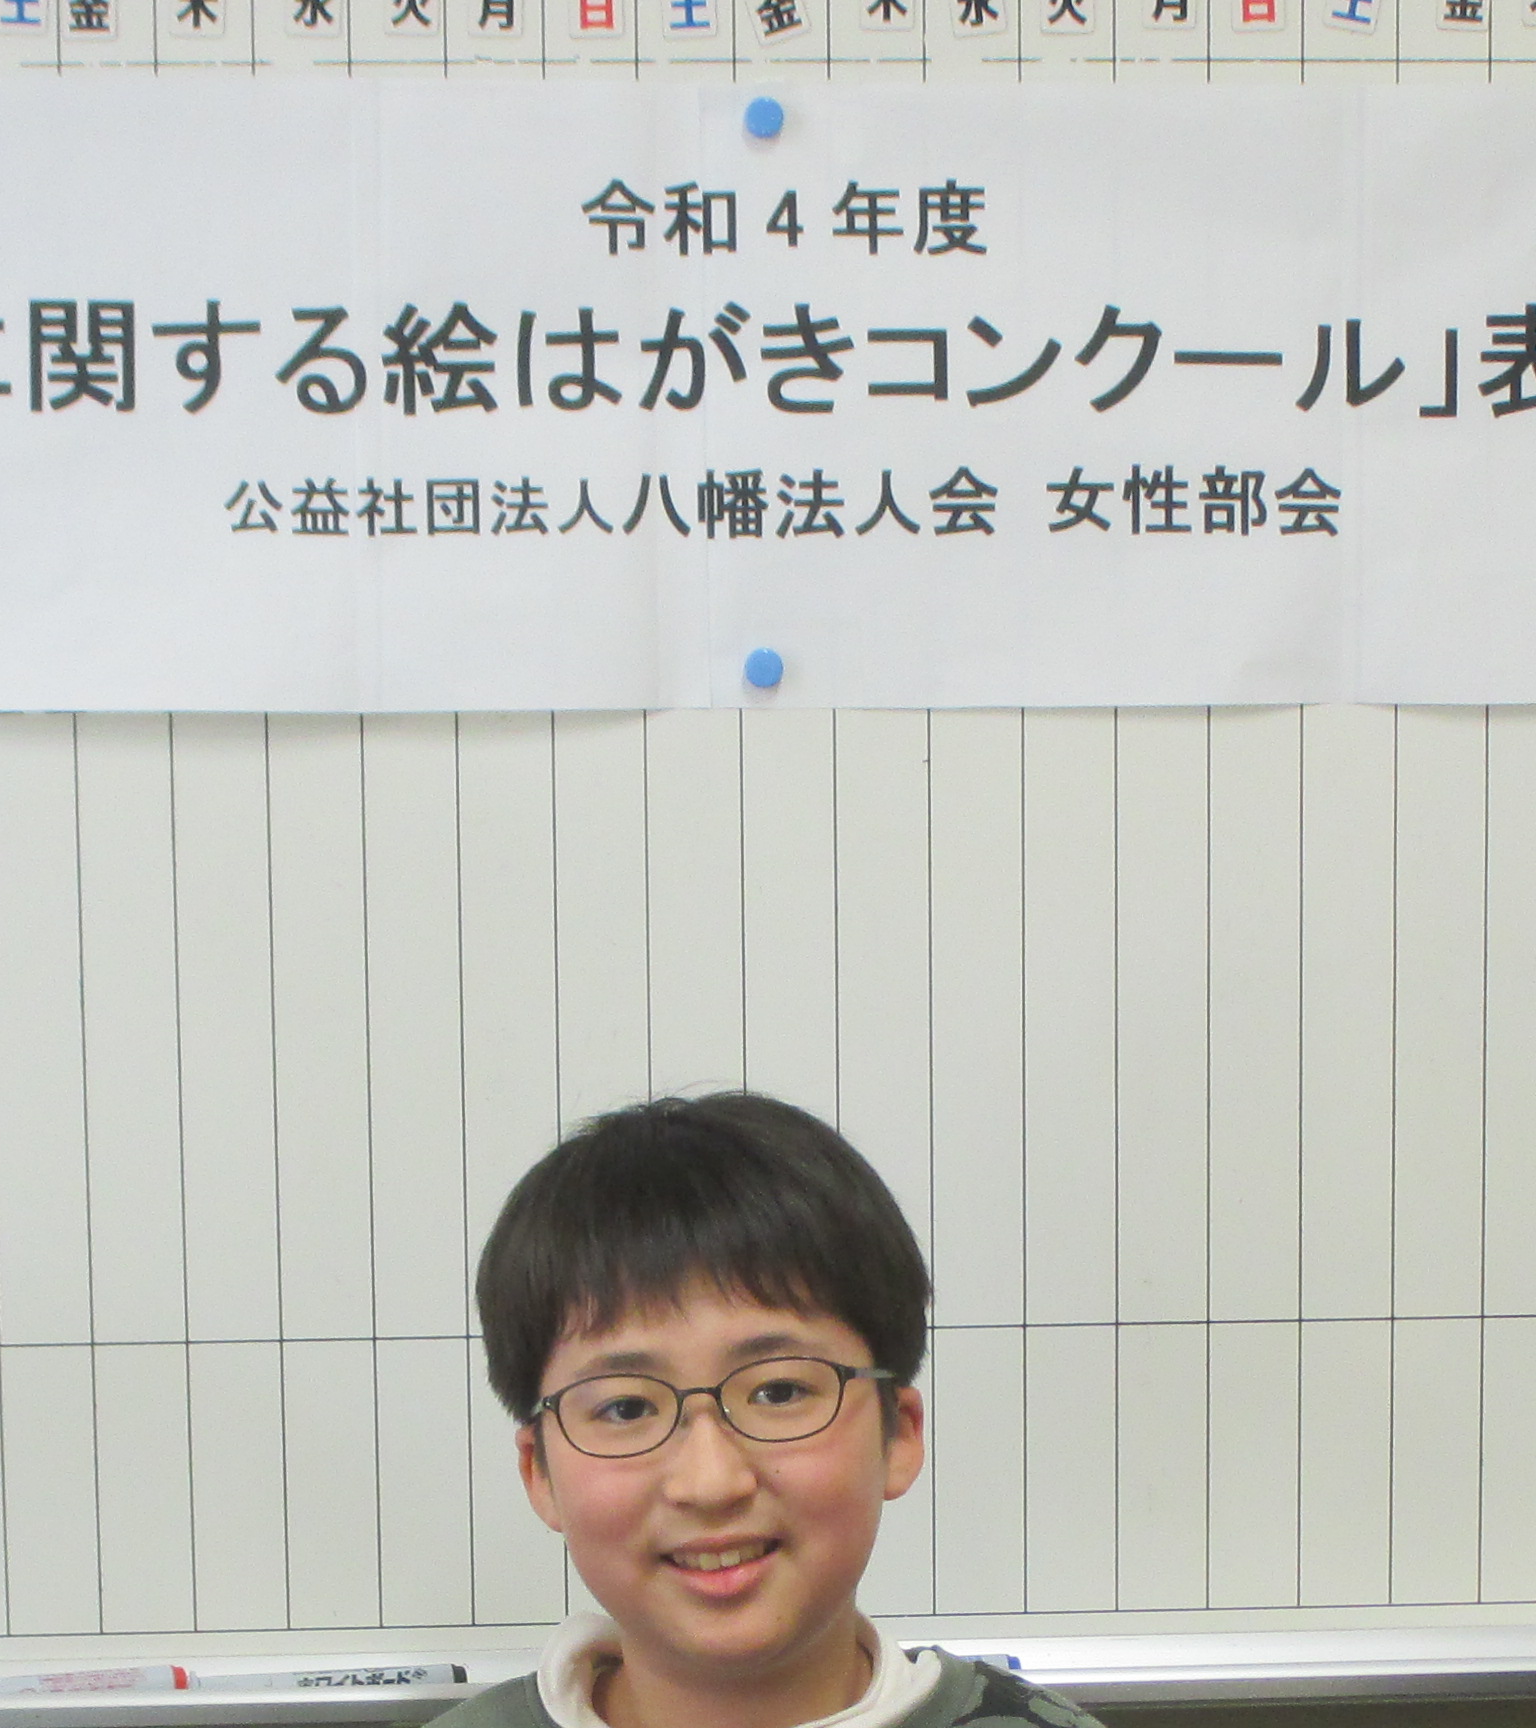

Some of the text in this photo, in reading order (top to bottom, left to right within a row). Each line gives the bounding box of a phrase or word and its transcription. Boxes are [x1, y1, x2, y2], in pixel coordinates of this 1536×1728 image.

[755, 0, 803, 38] 金
[226, 464, 1342, 540] 公益社団法人八幡法人会 女性部会
